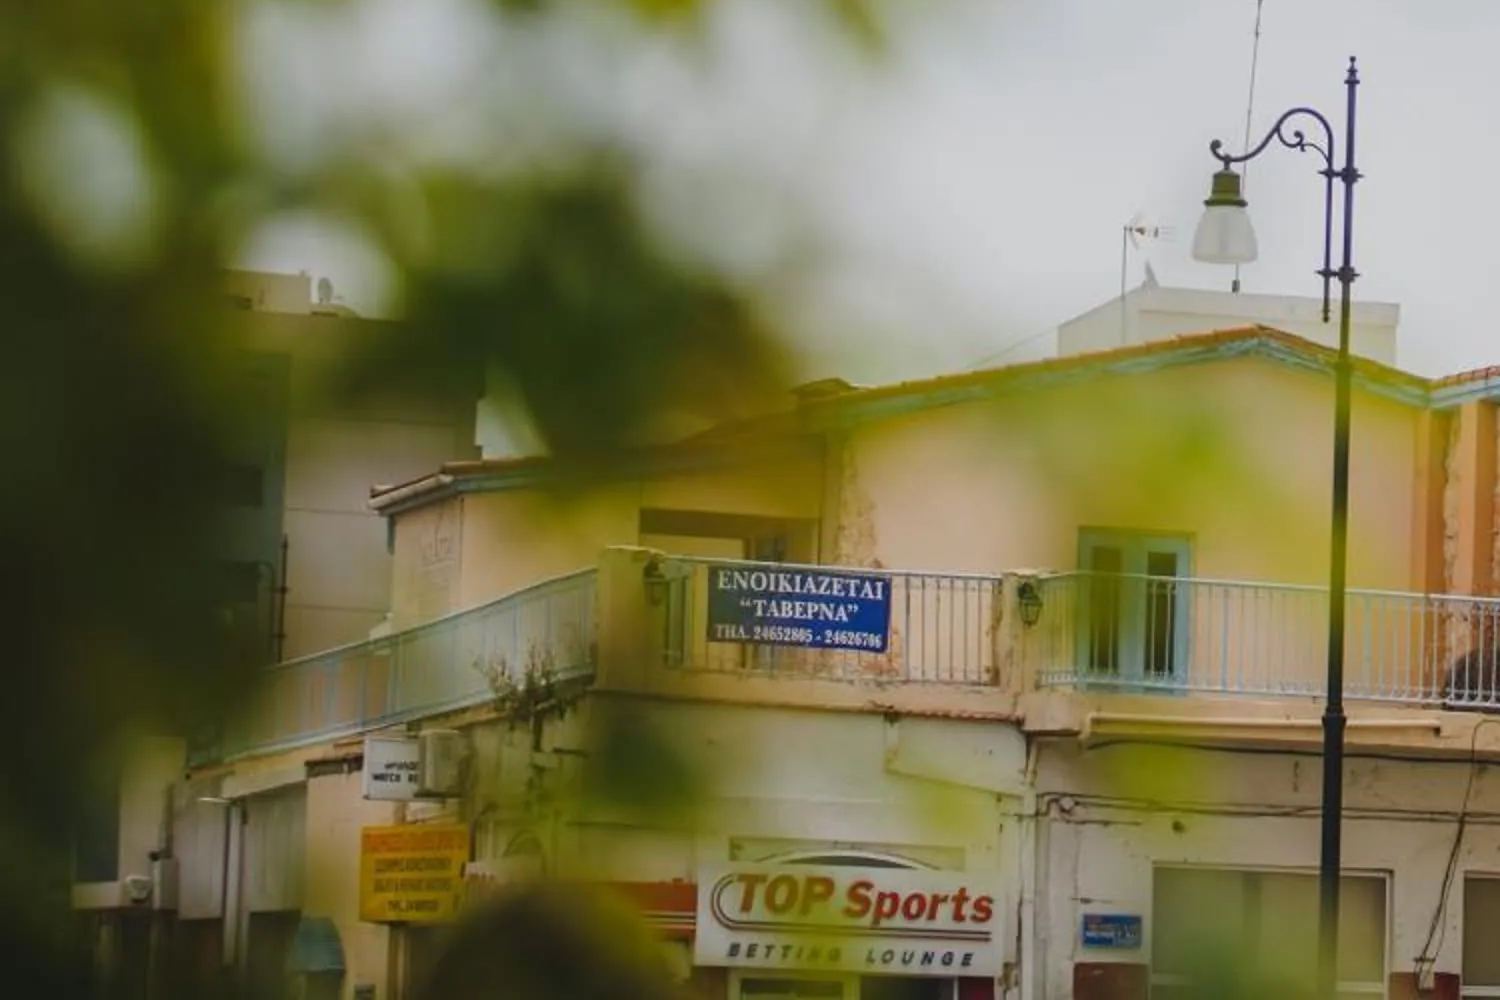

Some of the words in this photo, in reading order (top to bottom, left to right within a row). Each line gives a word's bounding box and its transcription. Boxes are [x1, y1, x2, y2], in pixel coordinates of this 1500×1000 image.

[718, 570, 884, 600] ΕΝΟΙΚΙΑΖΕΤΑΙ
[733, 873, 835, 916] TOP
[842, 880, 994, 926] Sports
[866, 950, 975, 967] LOUNGE
